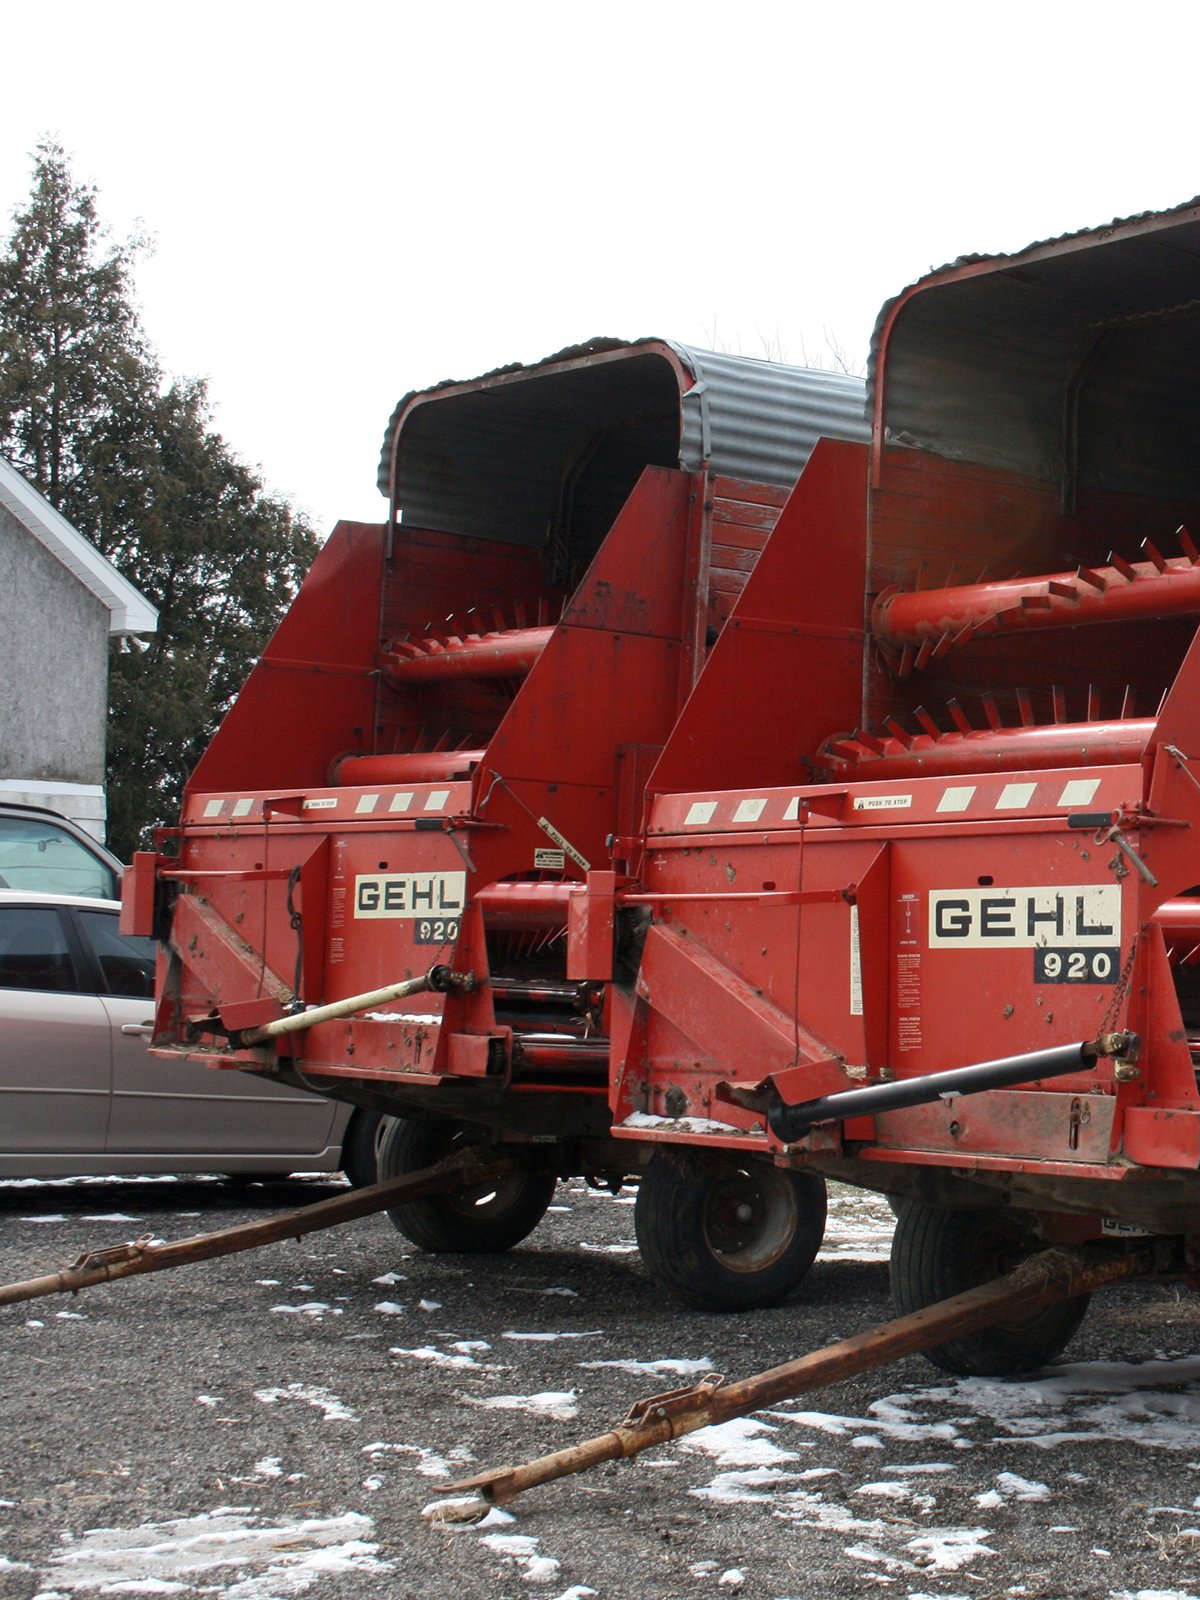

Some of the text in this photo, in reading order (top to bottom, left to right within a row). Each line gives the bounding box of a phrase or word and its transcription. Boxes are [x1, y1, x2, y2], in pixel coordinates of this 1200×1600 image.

[550, 831, 564, 846] PULL
[572, 853, 586, 866] STOP
[358, 879, 460, 911] GEHL
[420, 921, 459, 941] 920
[935, 896, 1113, 938] GEHL
[1043, 952, 1111, 978] 920
